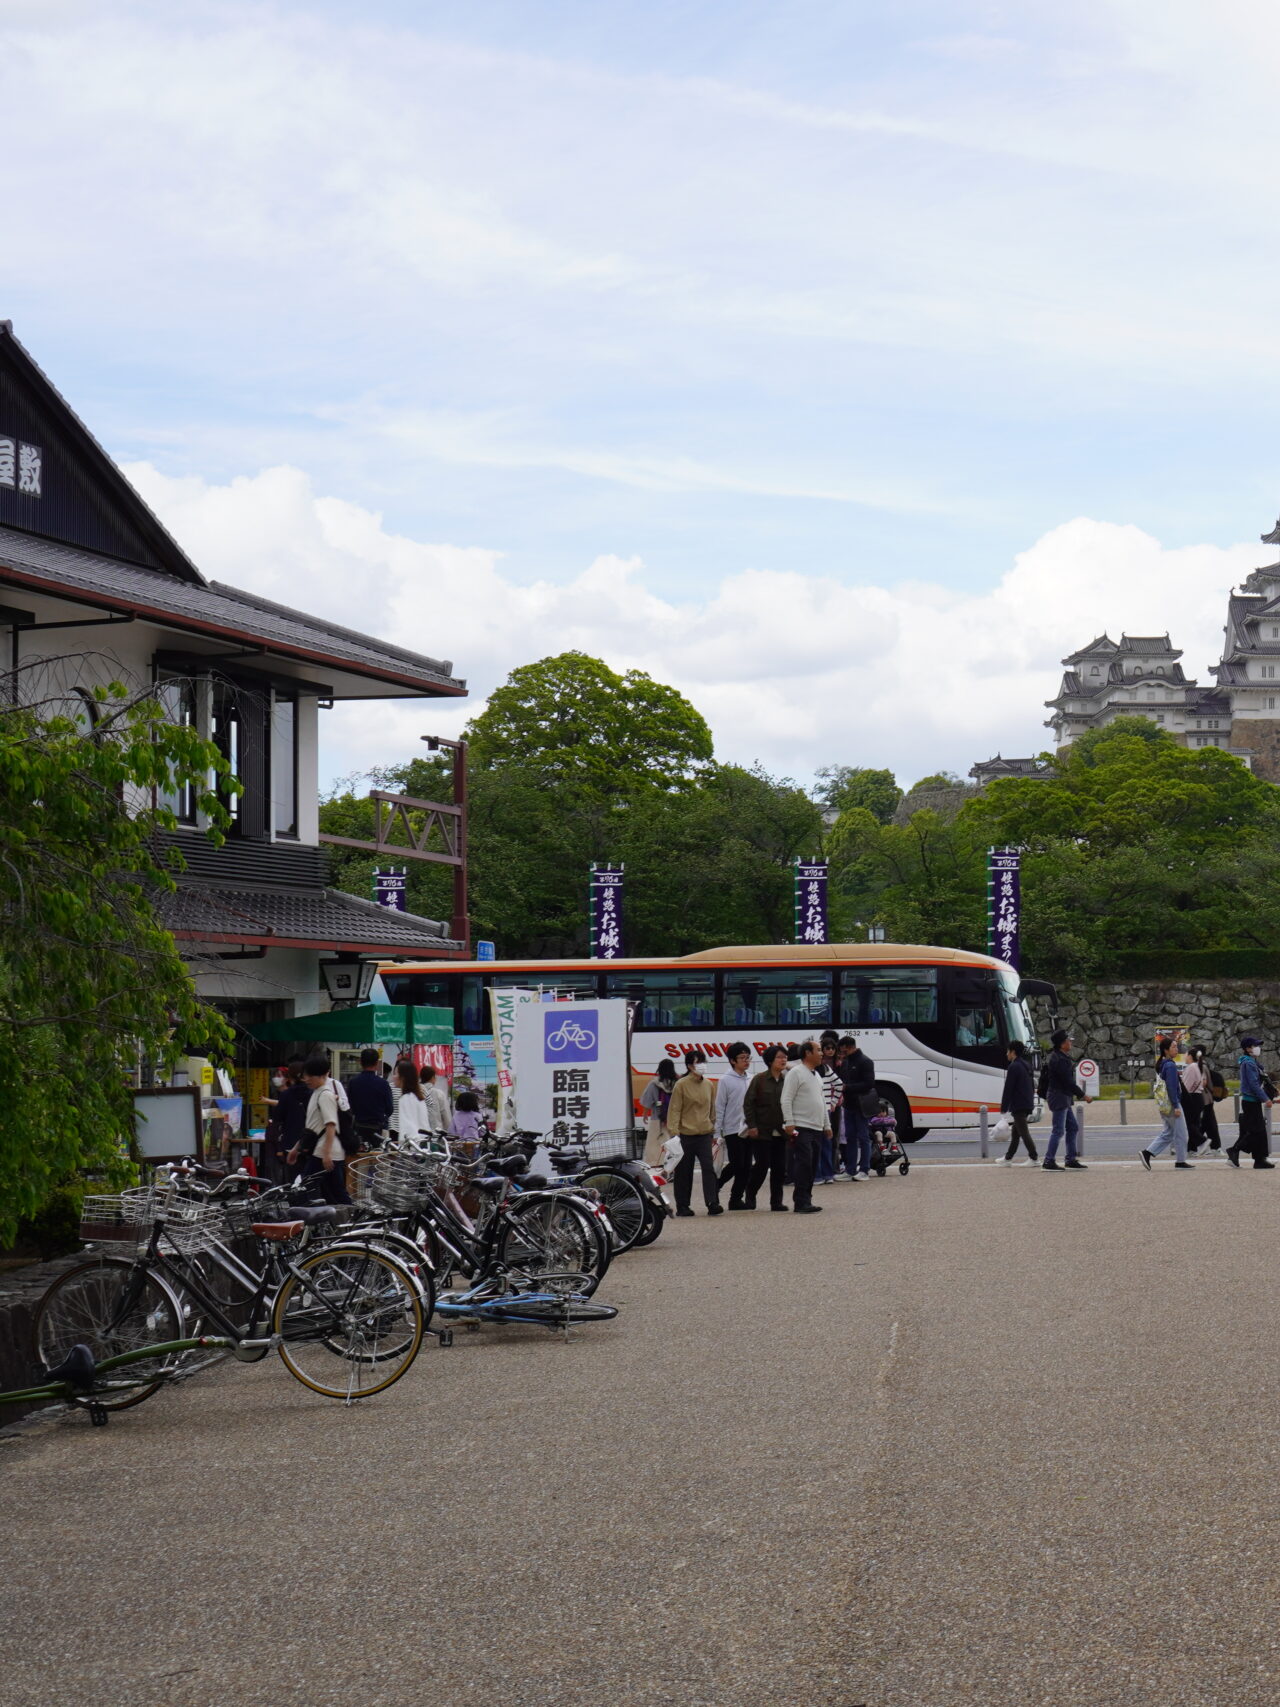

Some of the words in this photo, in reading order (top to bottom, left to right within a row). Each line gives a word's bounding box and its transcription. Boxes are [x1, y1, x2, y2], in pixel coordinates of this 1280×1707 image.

[804, 881, 824, 945] 姫路お城
[997, 872, 1017, 963] 姫路お城まつ
[664, 1042, 736, 1059] SHINK
